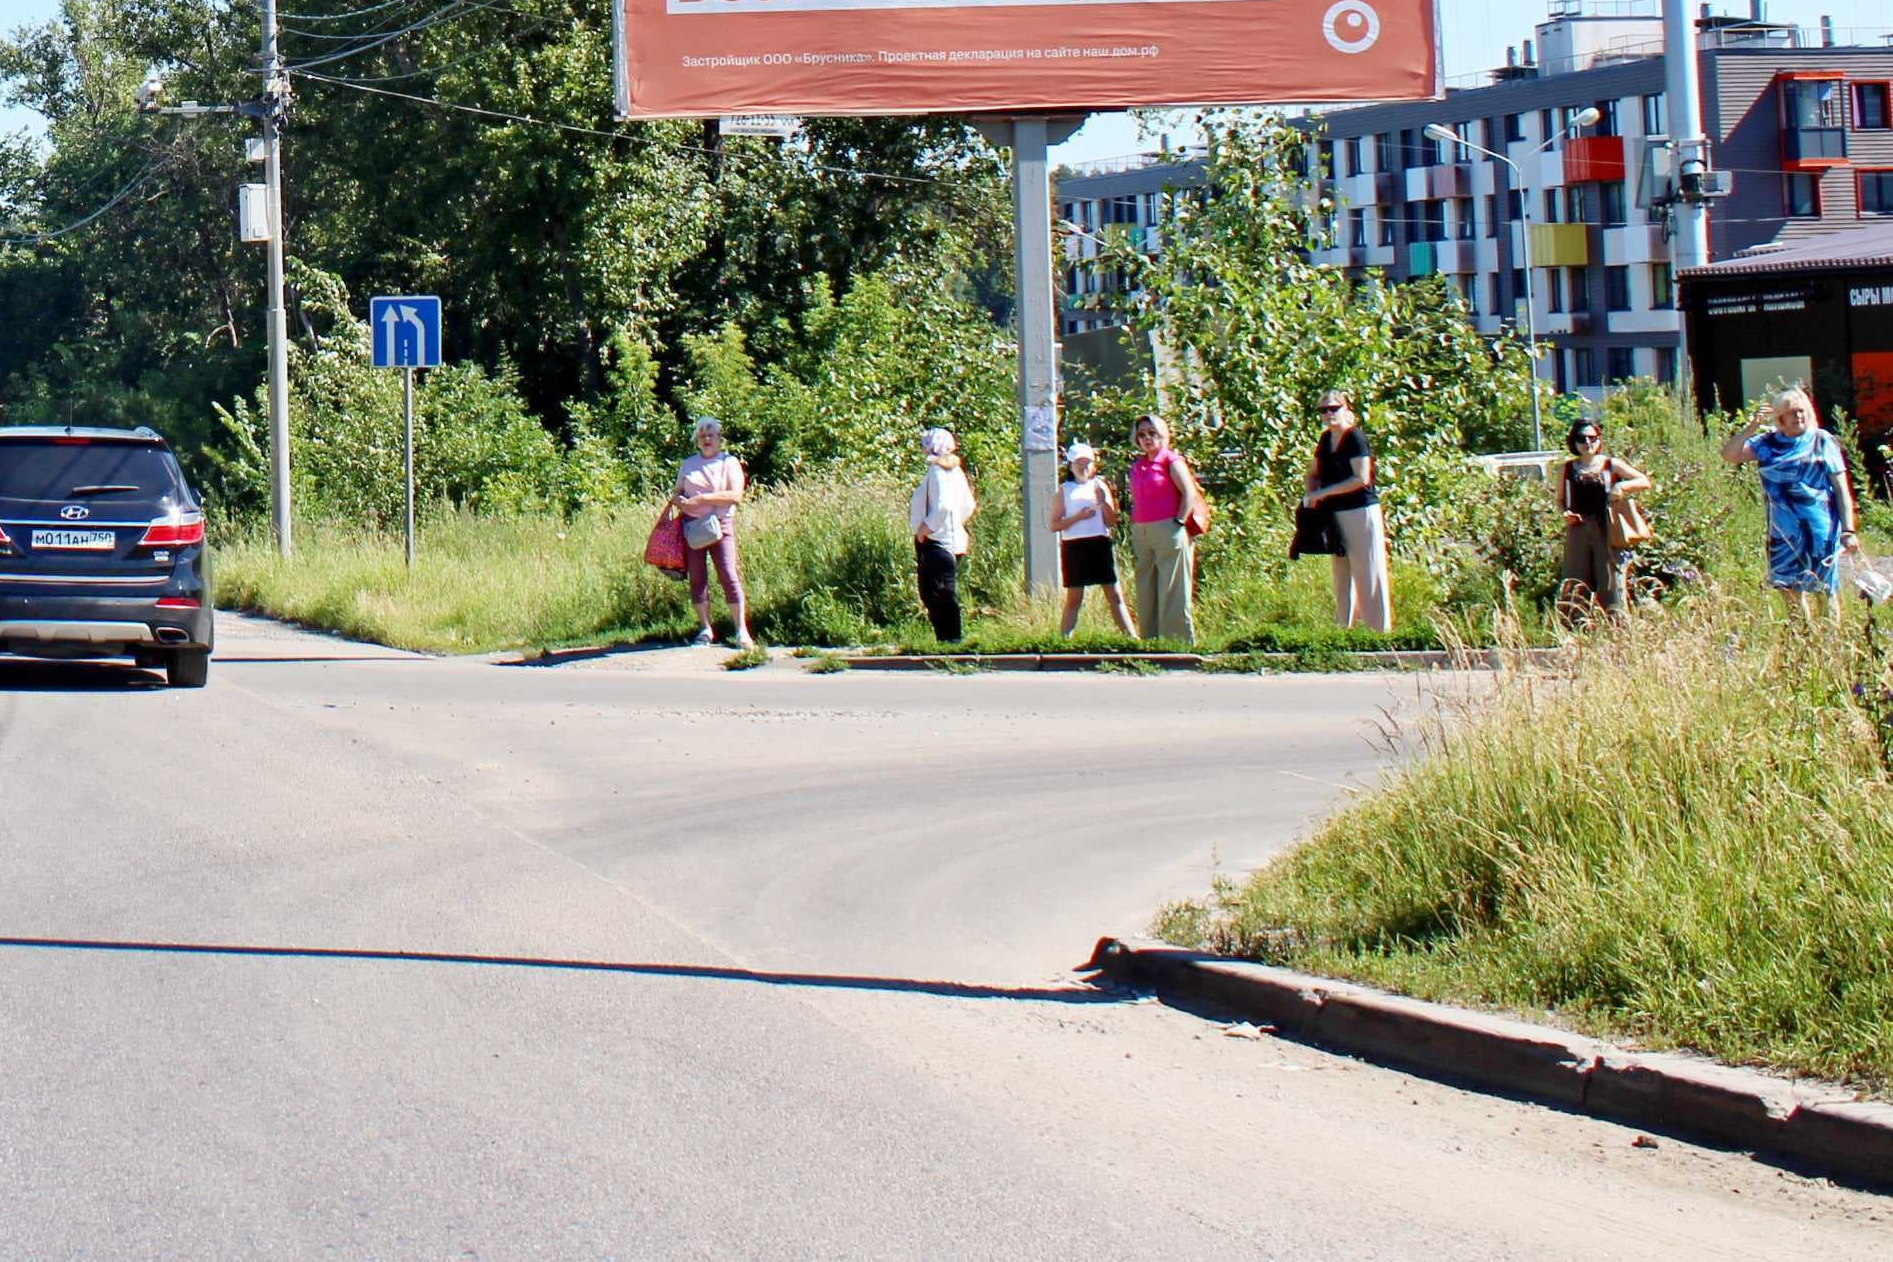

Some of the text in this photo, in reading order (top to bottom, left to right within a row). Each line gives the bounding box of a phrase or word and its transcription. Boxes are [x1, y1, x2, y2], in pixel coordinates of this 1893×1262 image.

[682, 54, 760, 68] Застройщик
[763, 53, 792, 65] ООО
[878, 49, 947, 63] Проектная
[948, 49, 1024, 61] декларация
[1026, 49, 1042, 59] на
[1044, 46, 1081, 59] сайте
[1083, 44, 1160, 58] наш.дом.рф
[1850, 287, 1880, 306] СЫРЫ
